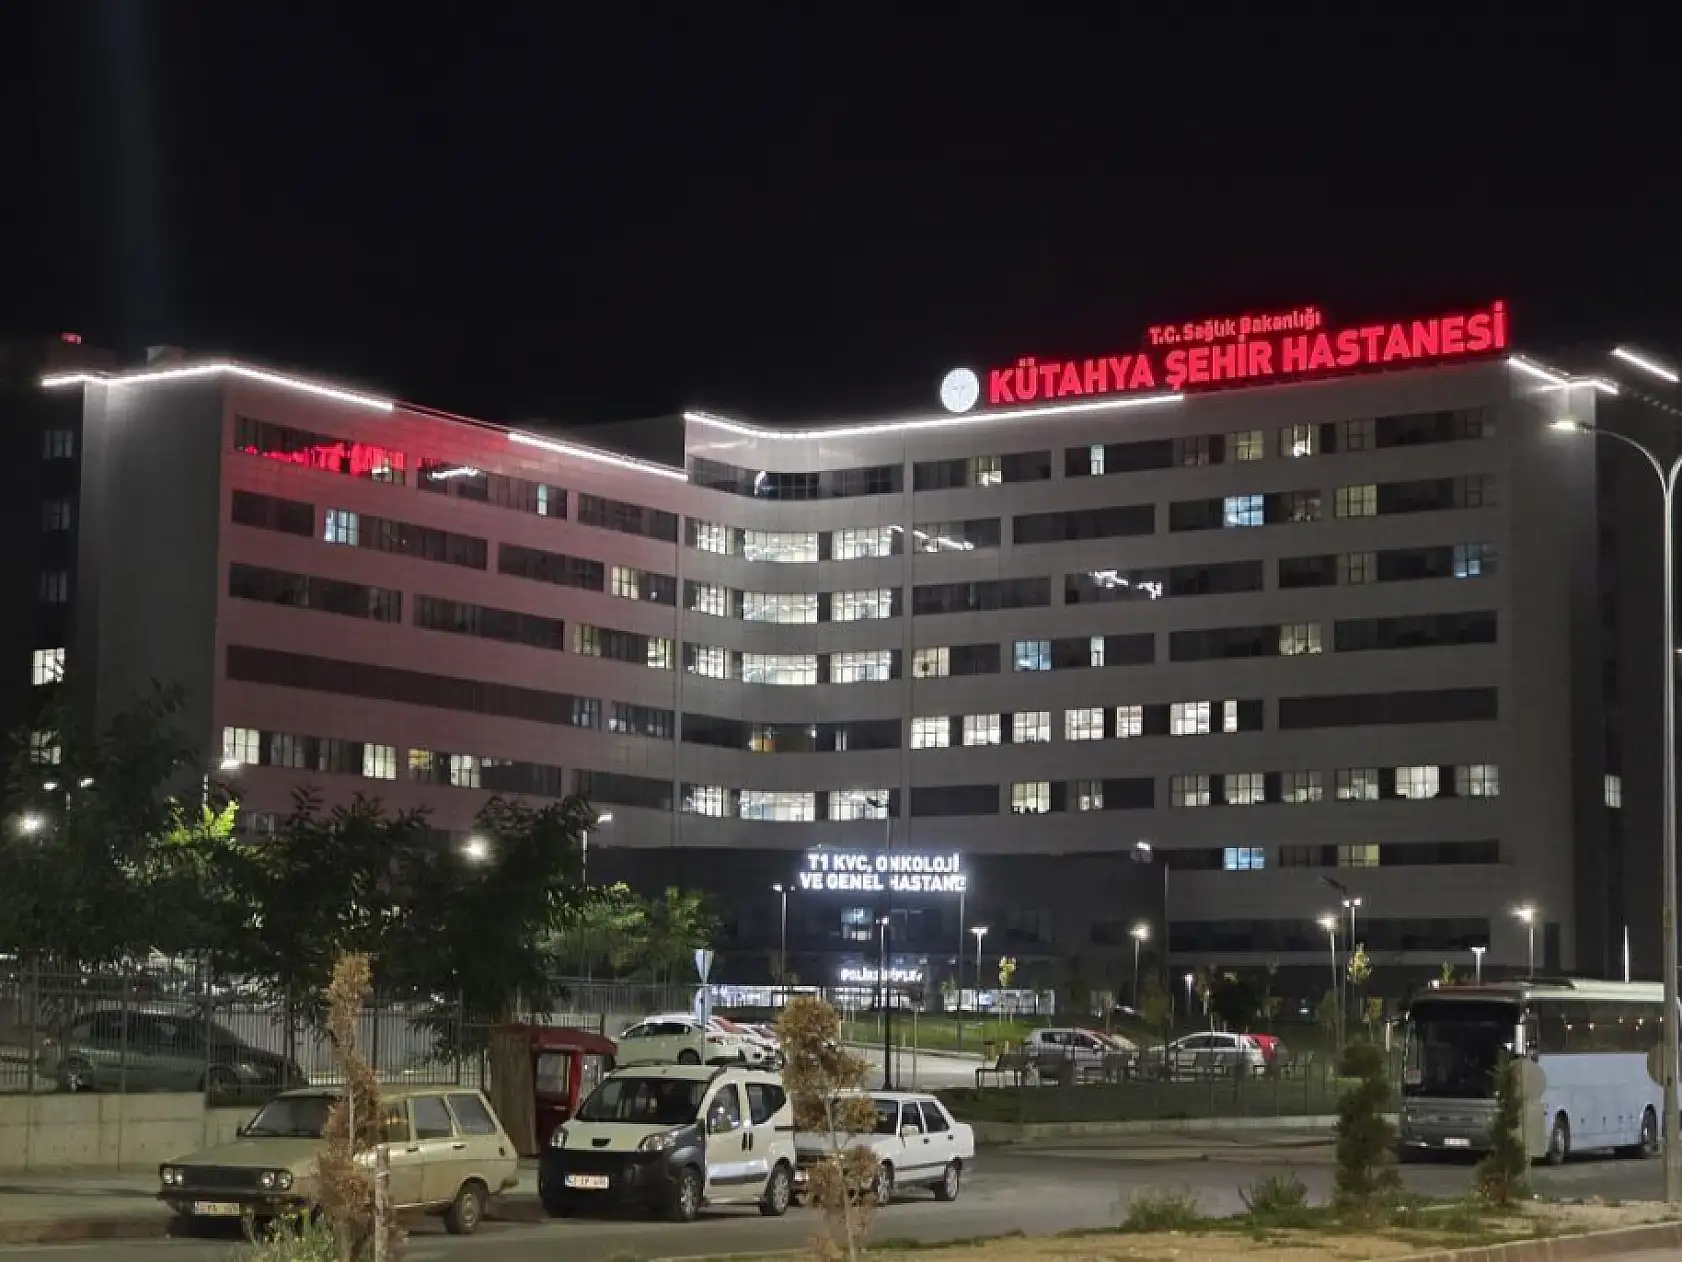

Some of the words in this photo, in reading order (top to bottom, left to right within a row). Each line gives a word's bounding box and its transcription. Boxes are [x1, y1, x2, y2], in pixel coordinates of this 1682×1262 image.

[1150, 324, 1180, 345] T.C.
[1183, 318, 1236, 342] Sağlık
[1239, 307, 1321, 334] Bakanlığı
[990, 357, 1154, 403] KÜTAHYA
[1165, 335, 1274, 391] ŞEHİR
[1282, 301, 1505, 372] HASTANESİ
[808, 853, 829, 871] T1
[800, 872, 823, 890] VE
[827, 873, 885, 891] GENEL
